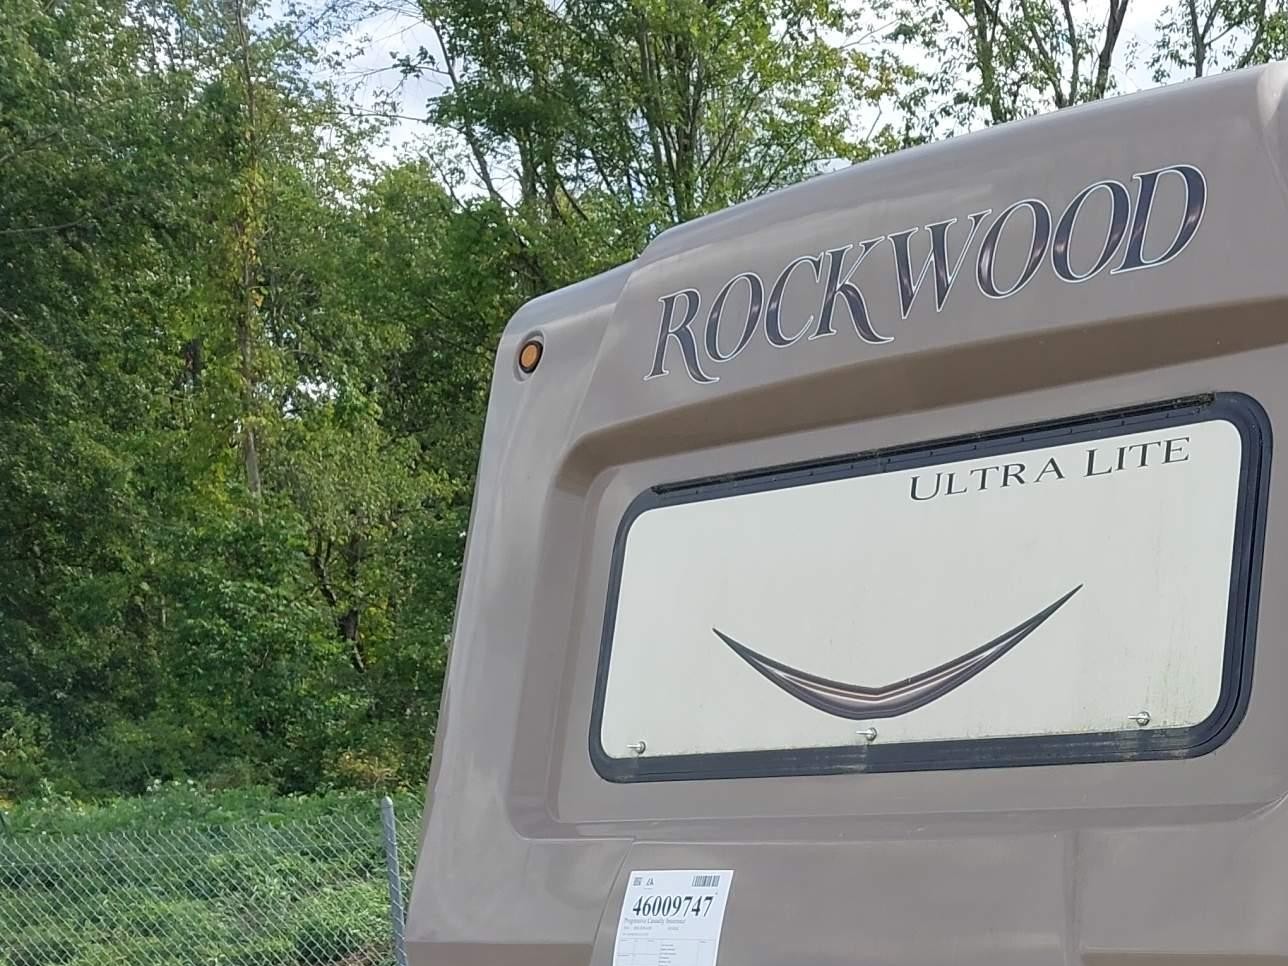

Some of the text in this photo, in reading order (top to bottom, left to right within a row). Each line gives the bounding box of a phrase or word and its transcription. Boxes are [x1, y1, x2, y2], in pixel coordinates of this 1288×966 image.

[644, 163, 1209, 384] ROCKWOOD
[909, 436, 1190, 501] ULTRA LITE
[632, 895, 714, 917] 46009747
